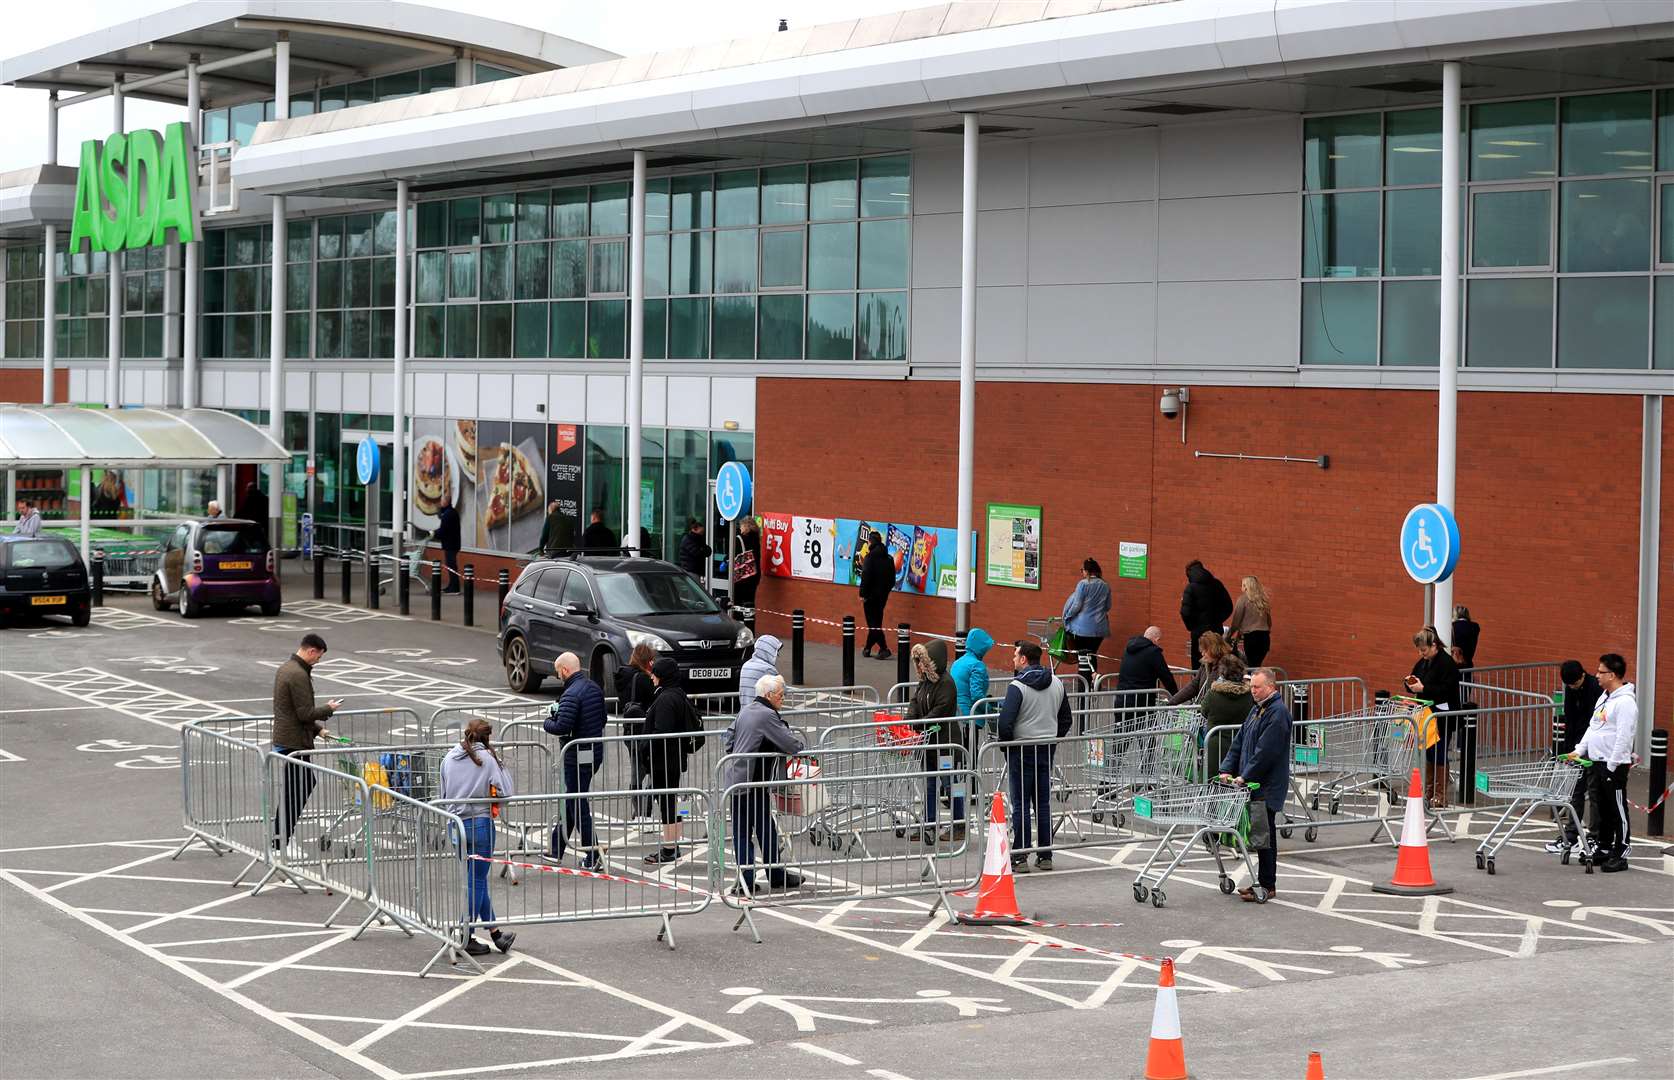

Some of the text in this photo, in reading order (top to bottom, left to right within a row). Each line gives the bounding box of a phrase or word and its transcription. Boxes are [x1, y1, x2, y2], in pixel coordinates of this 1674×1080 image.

[70, 121, 199, 255] ASDA
[551, 464, 581, 474] COFFEE FROM
[557, 472, 576, 481] SEATTLE
[563, 500, 577, 508] FROM
[763, 518, 789, 533] Multi Buy
[805, 519, 822, 536] 3 for
[766, 534, 785, 566] £3
[803, 539, 822, 568] £8
[692, 669, 729, 678] DE08 UZG
